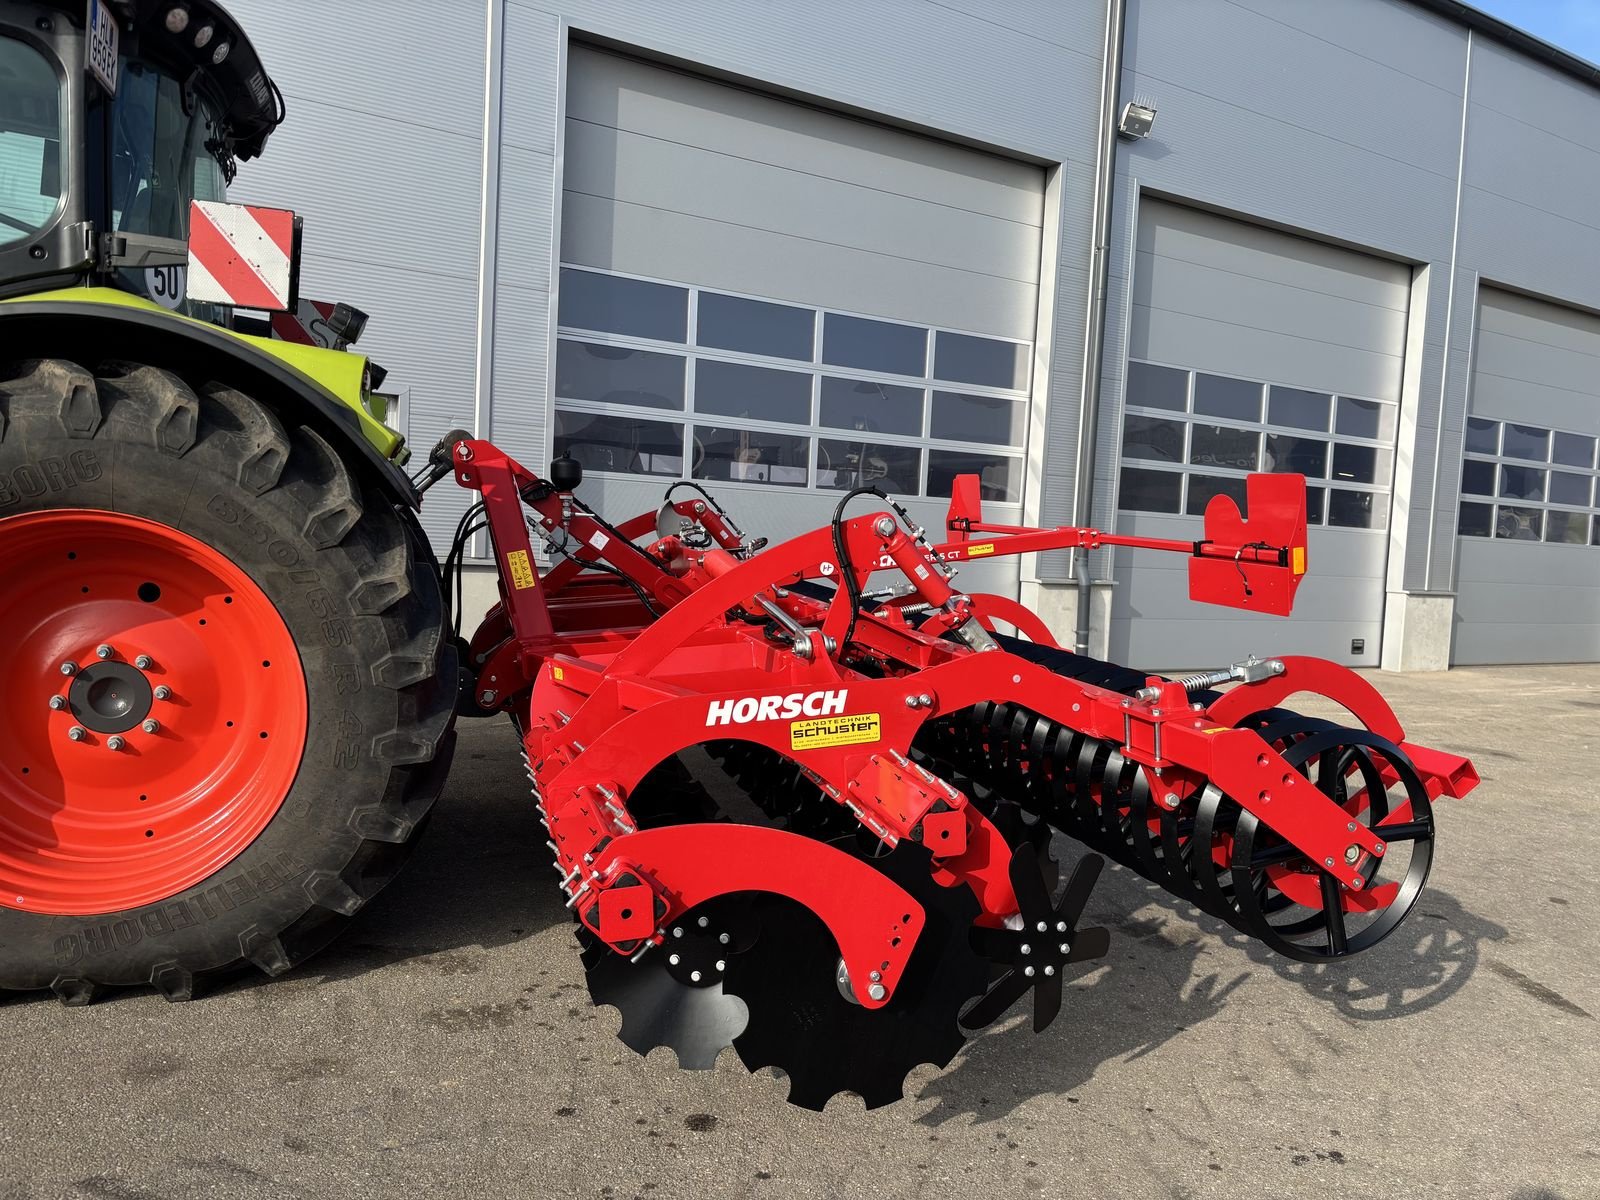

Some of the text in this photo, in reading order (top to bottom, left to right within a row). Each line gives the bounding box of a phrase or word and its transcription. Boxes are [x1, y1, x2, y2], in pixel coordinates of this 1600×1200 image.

[153, 266, 179, 300] 50
[947, 550, 961, 559] CT
[337, 663, 361, 697] R
[705, 689, 848, 727] HORSCH
[799, 715, 872, 728] LANDTECHNIK
[333, 709, 364, 771] 42
[793, 721, 878, 739] schuster
[52, 850, 307, 967] TRELLEBORG
